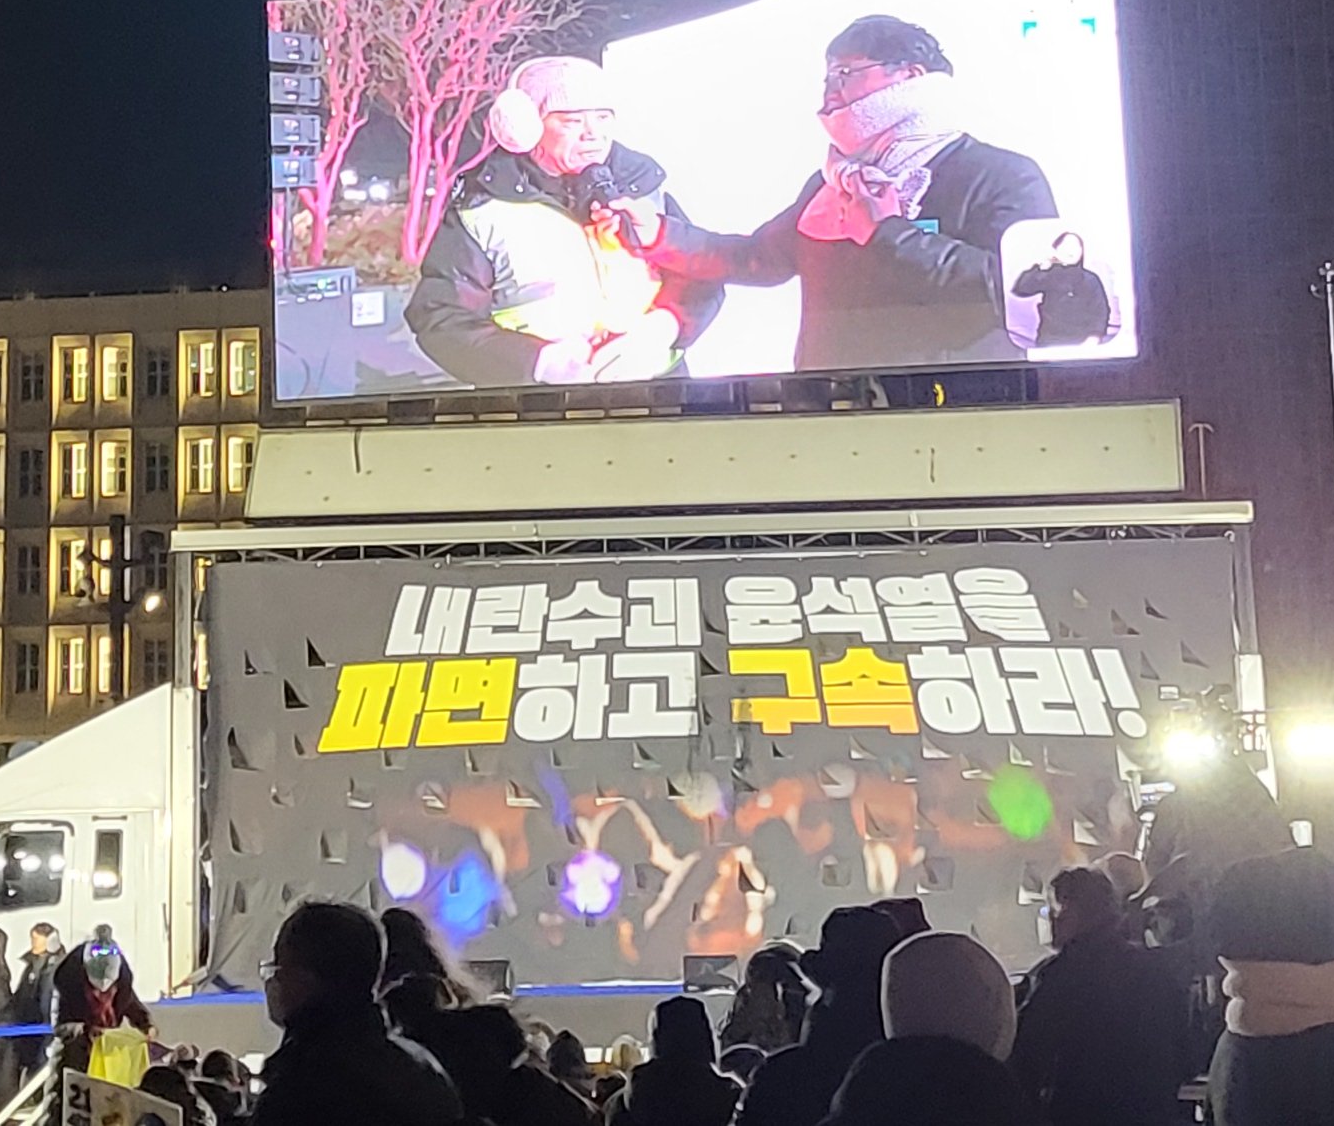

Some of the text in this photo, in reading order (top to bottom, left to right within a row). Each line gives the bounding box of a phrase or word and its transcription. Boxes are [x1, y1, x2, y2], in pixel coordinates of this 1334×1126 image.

[385, 567, 1052, 657] 내란수괴 윤석열을
[317, 645, 1148, 753] 파면하고 구속하라!
